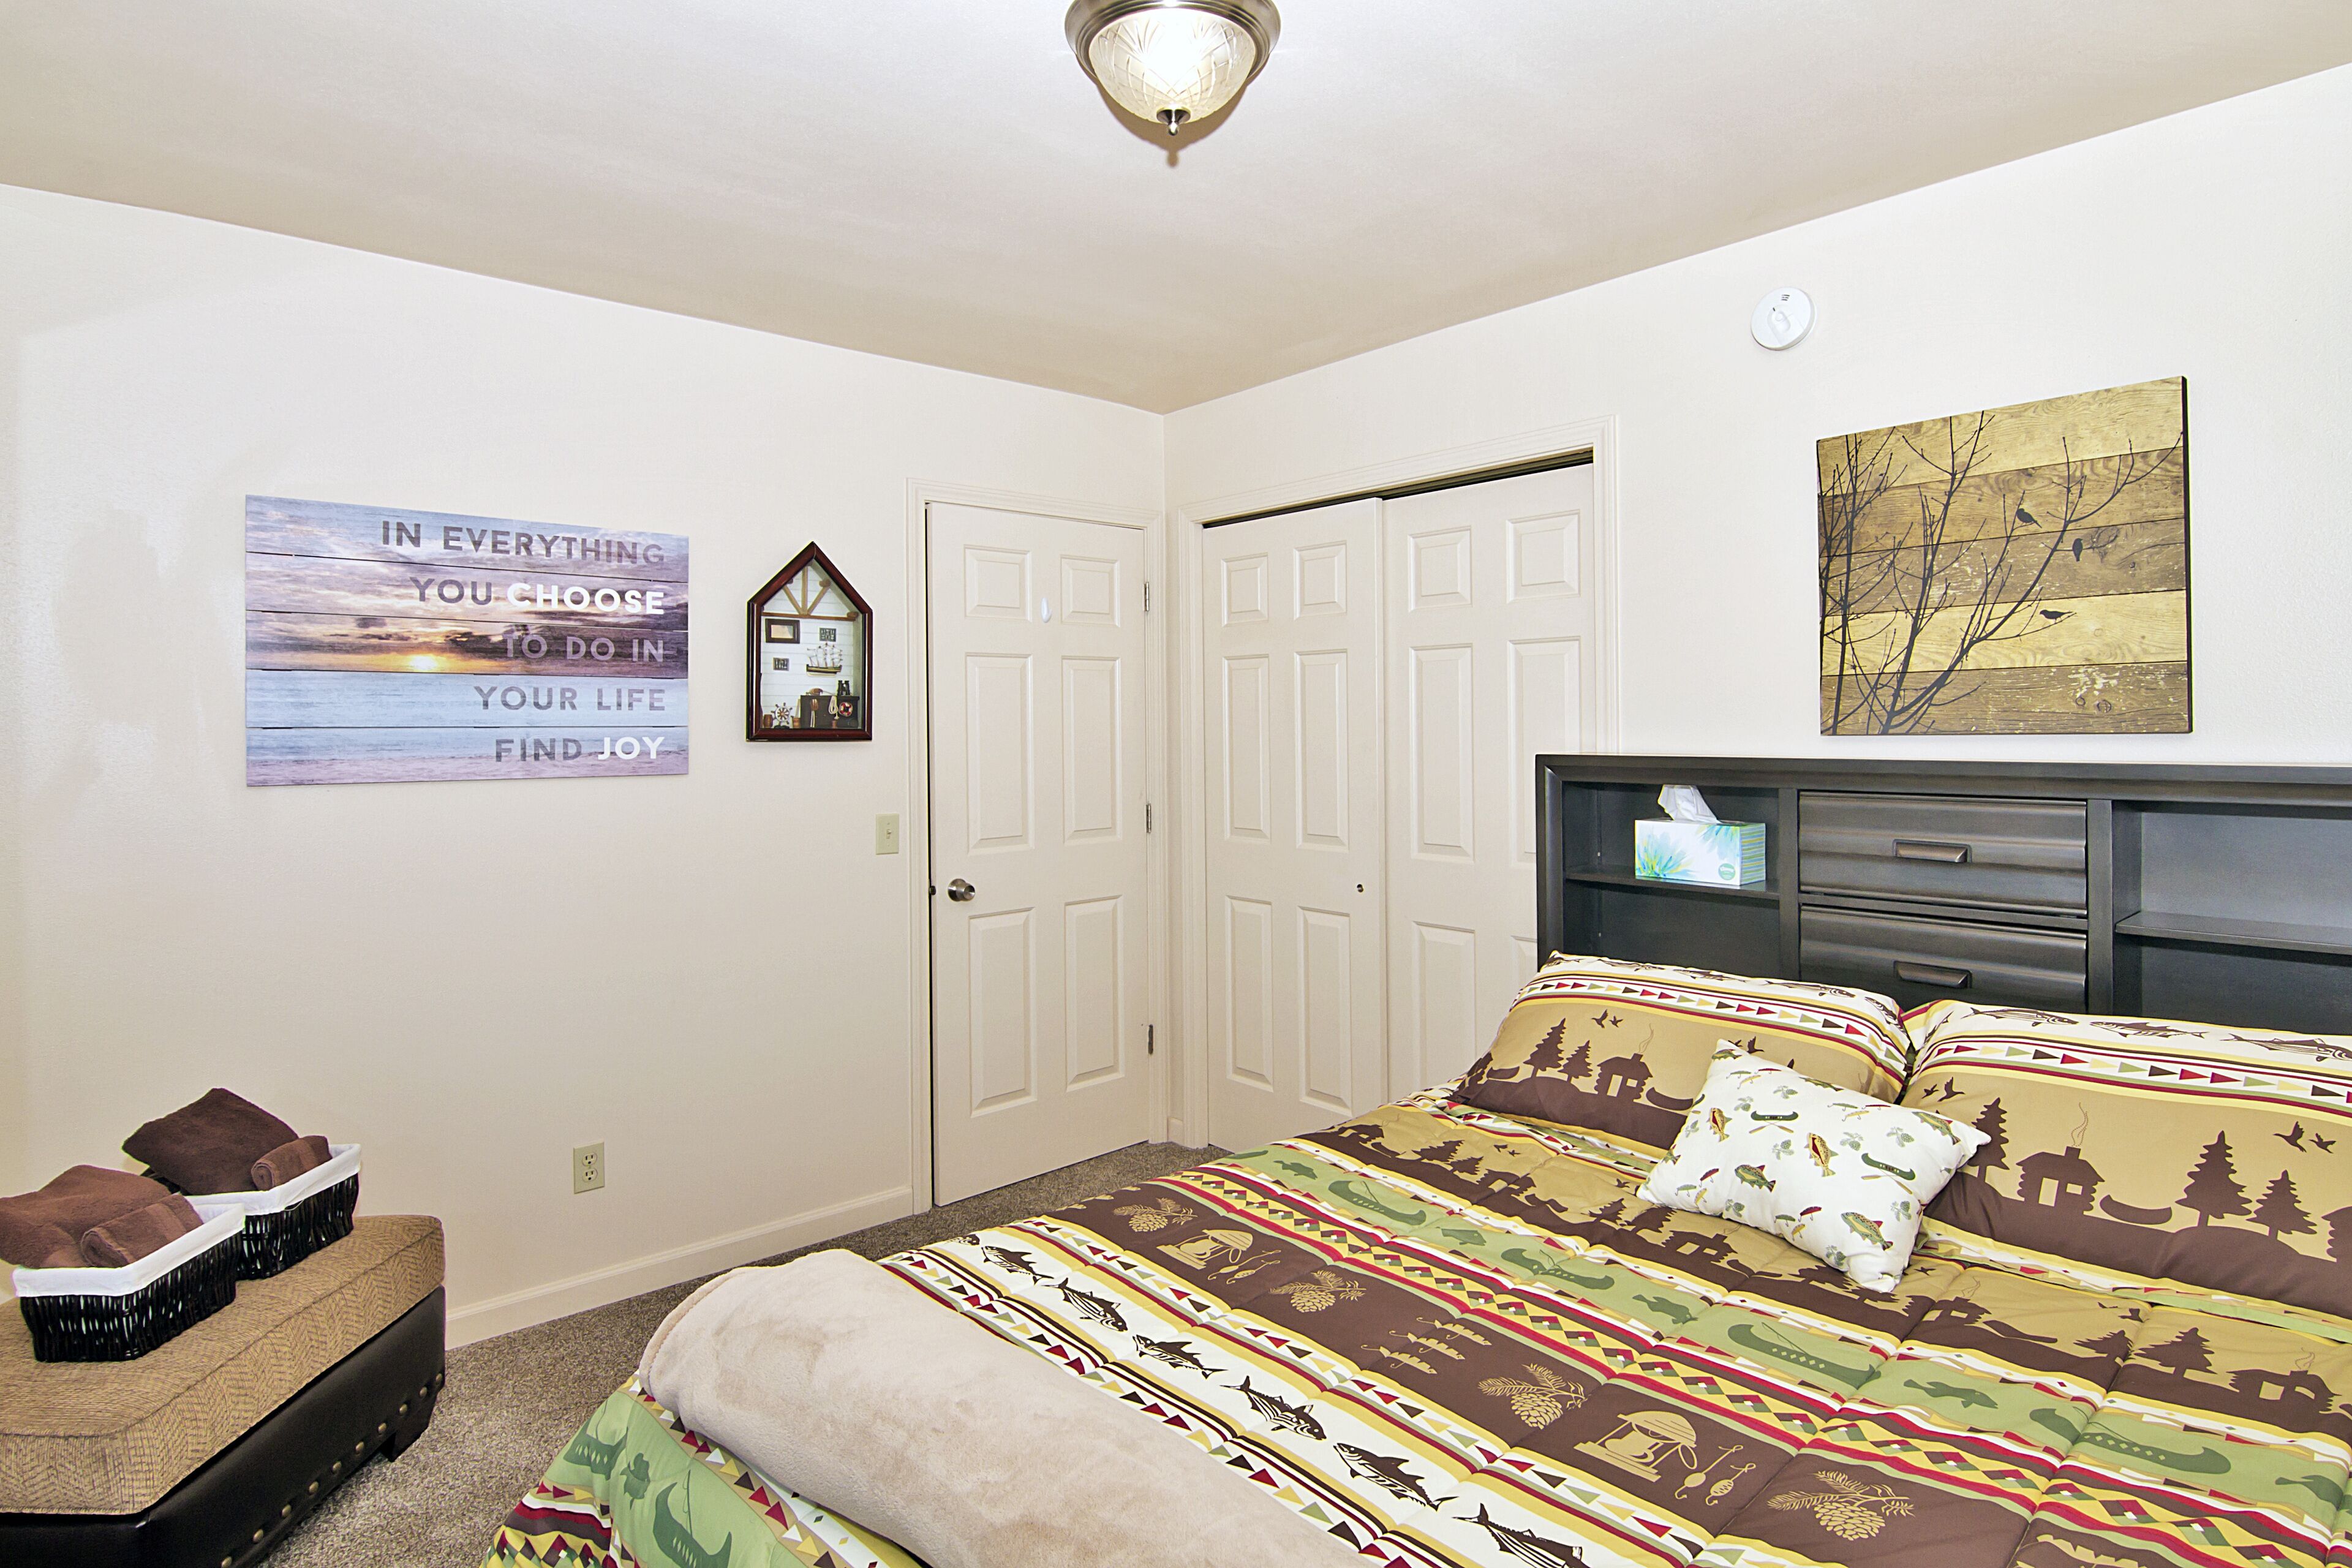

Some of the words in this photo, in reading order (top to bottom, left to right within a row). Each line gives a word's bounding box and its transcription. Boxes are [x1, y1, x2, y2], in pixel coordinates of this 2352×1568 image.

[382, 520, 421, 548] IN
[443, 526, 665, 565] EVERYTHING
[409, 576, 492, 605] YOU
[507, 582, 665, 615] CHOOSE
[502, 634, 547, 659] TO
[567, 635, 614, 662] DO
[633, 639, 664, 662] IN
[473, 686, 578, 711] YOUR
[597, 688, 666, 711] LIFE
[495, 738, 582, 763] FIND
[597, 737, 666, 760] JOY
